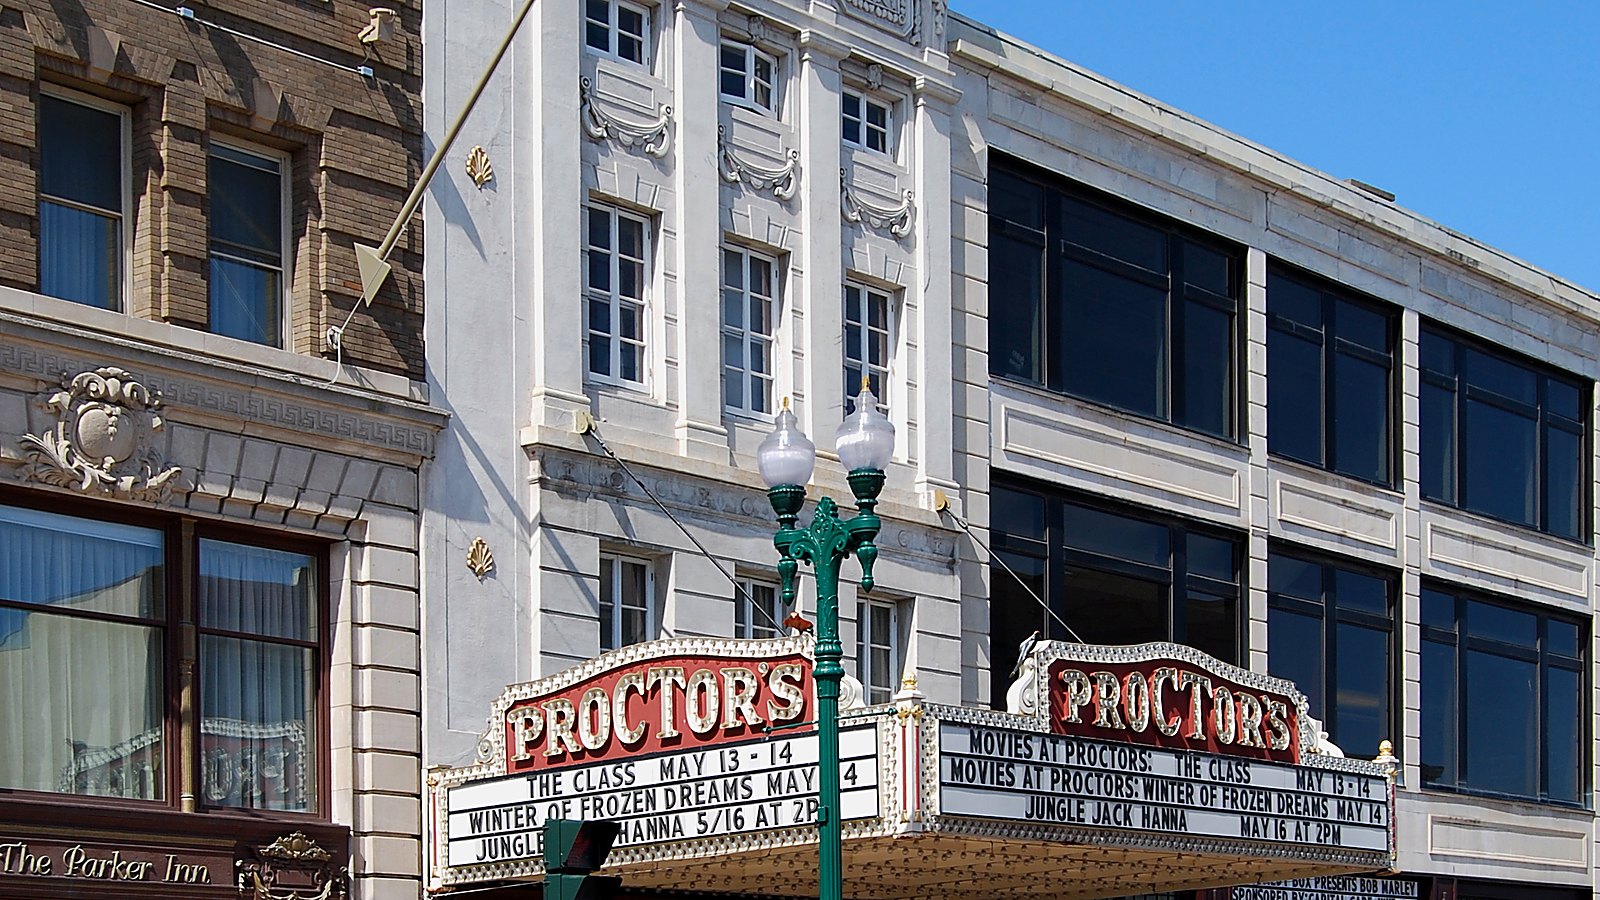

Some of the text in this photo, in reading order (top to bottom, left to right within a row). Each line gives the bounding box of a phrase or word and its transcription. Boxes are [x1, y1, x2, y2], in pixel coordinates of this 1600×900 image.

[506, 662, 803, 762] PROCTOR'S
[1059, 666, 1291, 751] PROCTOR'S
[527, 772, 563, 798] THE
[573, 763, 636, 793] CLASS
[660, 752, 706, 781] MAY
[719, 749, 739, 773] 13
[771, 741, 792, 765] 14
[969, 729, 1033, 759] MOVIES
[1039, 738, 1060, 763] AT
[1065, 741, 1152, 772] PROCTORS:
[1175, 755, 1201, 779] THE
[1209, 759, 1251, 784] CLASS
[1297, 768, 1324, 792] MAY
[469, 804, 537, 834] WINTER
[548, 799, 571, 820] OF
[581, 789, 657, 820] FROZEN
[664, 776, 753, 810] DREAMS
[767, 767, 818, 797] MAY
[950, 757, 1382, 824] MOVIES AT PROCTORS: WINTER OF FROZEN DREAMS MAY 14
[476, 832, 544, 861] JUNGLE
[616, 814, 685, 844] HANNA
[696, 807, 745, 835] 5/16
[755, 802, 782, 828] AT
[1025, 796, 1341, 846] JUNGLE JACK HANNA MAY 16 AT 2PM
[0, 842, 210, 884] The Parker Inn
[1315, 876, 1357, 892] PRESENTS
[1360, 878, 1378, 893] BOB
[1382, 880, 1415, 896] MARLEY
[1232, 887, 1288, 900] SPONSORED
